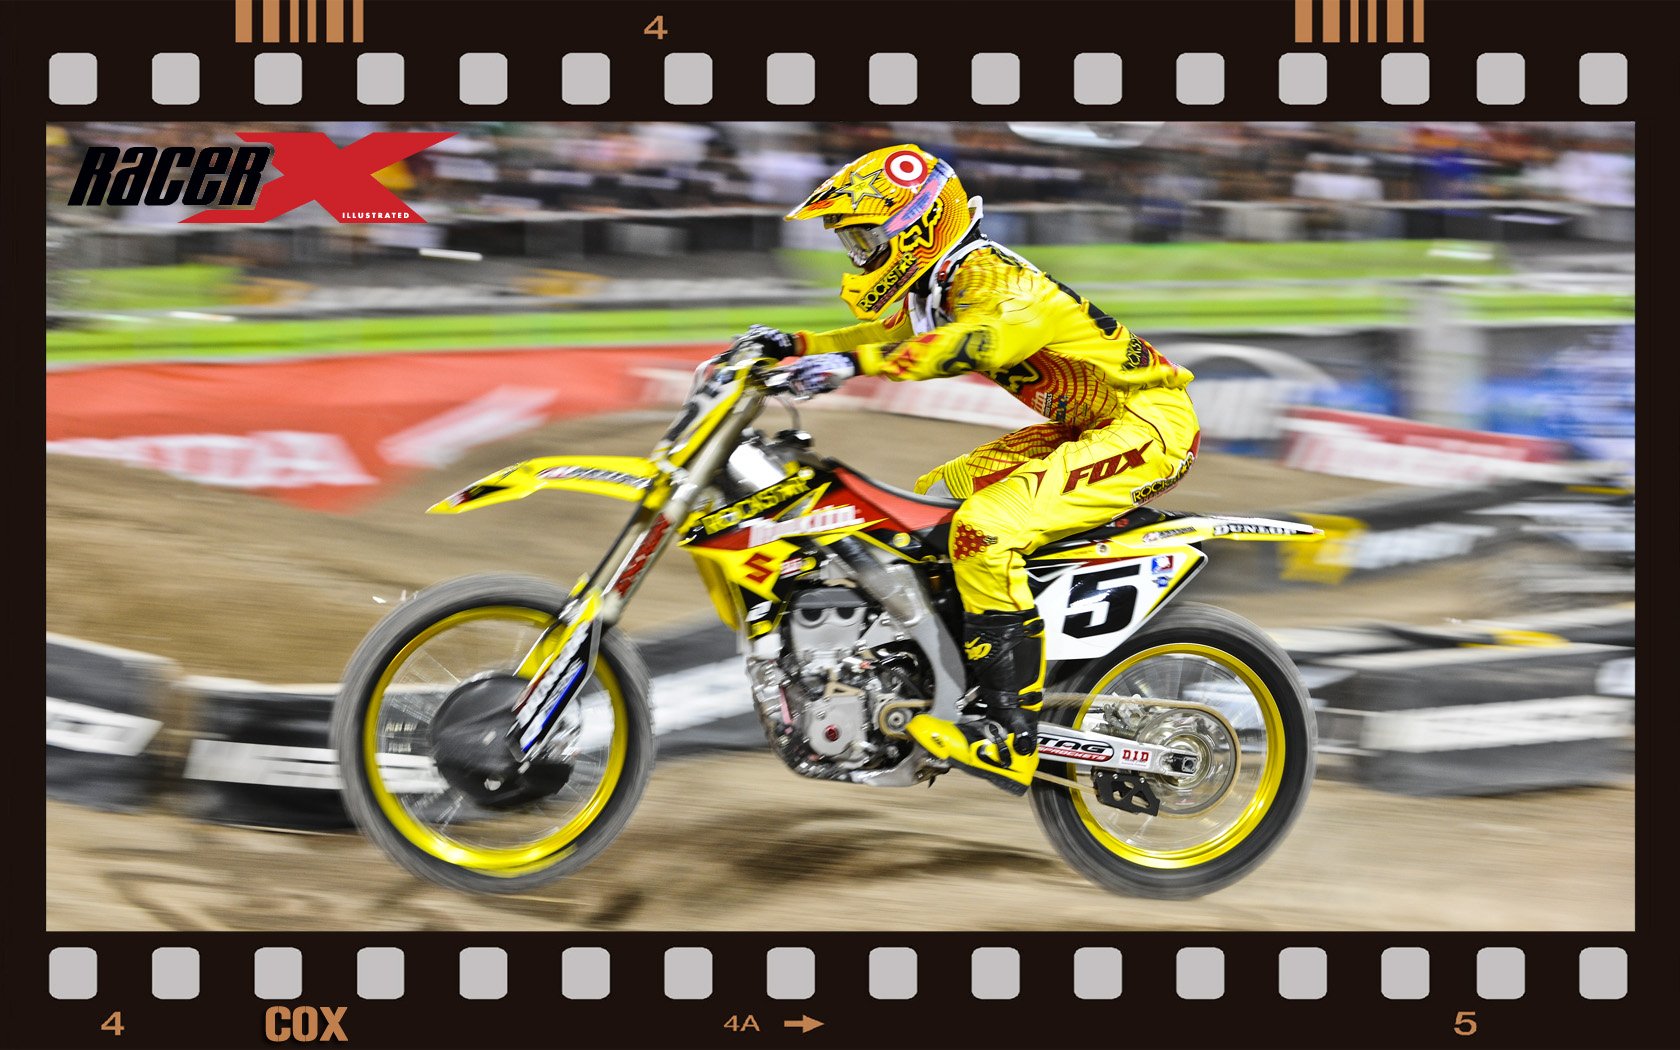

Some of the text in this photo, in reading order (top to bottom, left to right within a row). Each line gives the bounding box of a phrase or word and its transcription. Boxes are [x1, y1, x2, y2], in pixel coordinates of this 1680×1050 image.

[1062, 439, 1154, 495] FOX
[1062, 563, 1142, 640] 5
[1038, 736, 1112, 753] TAG
